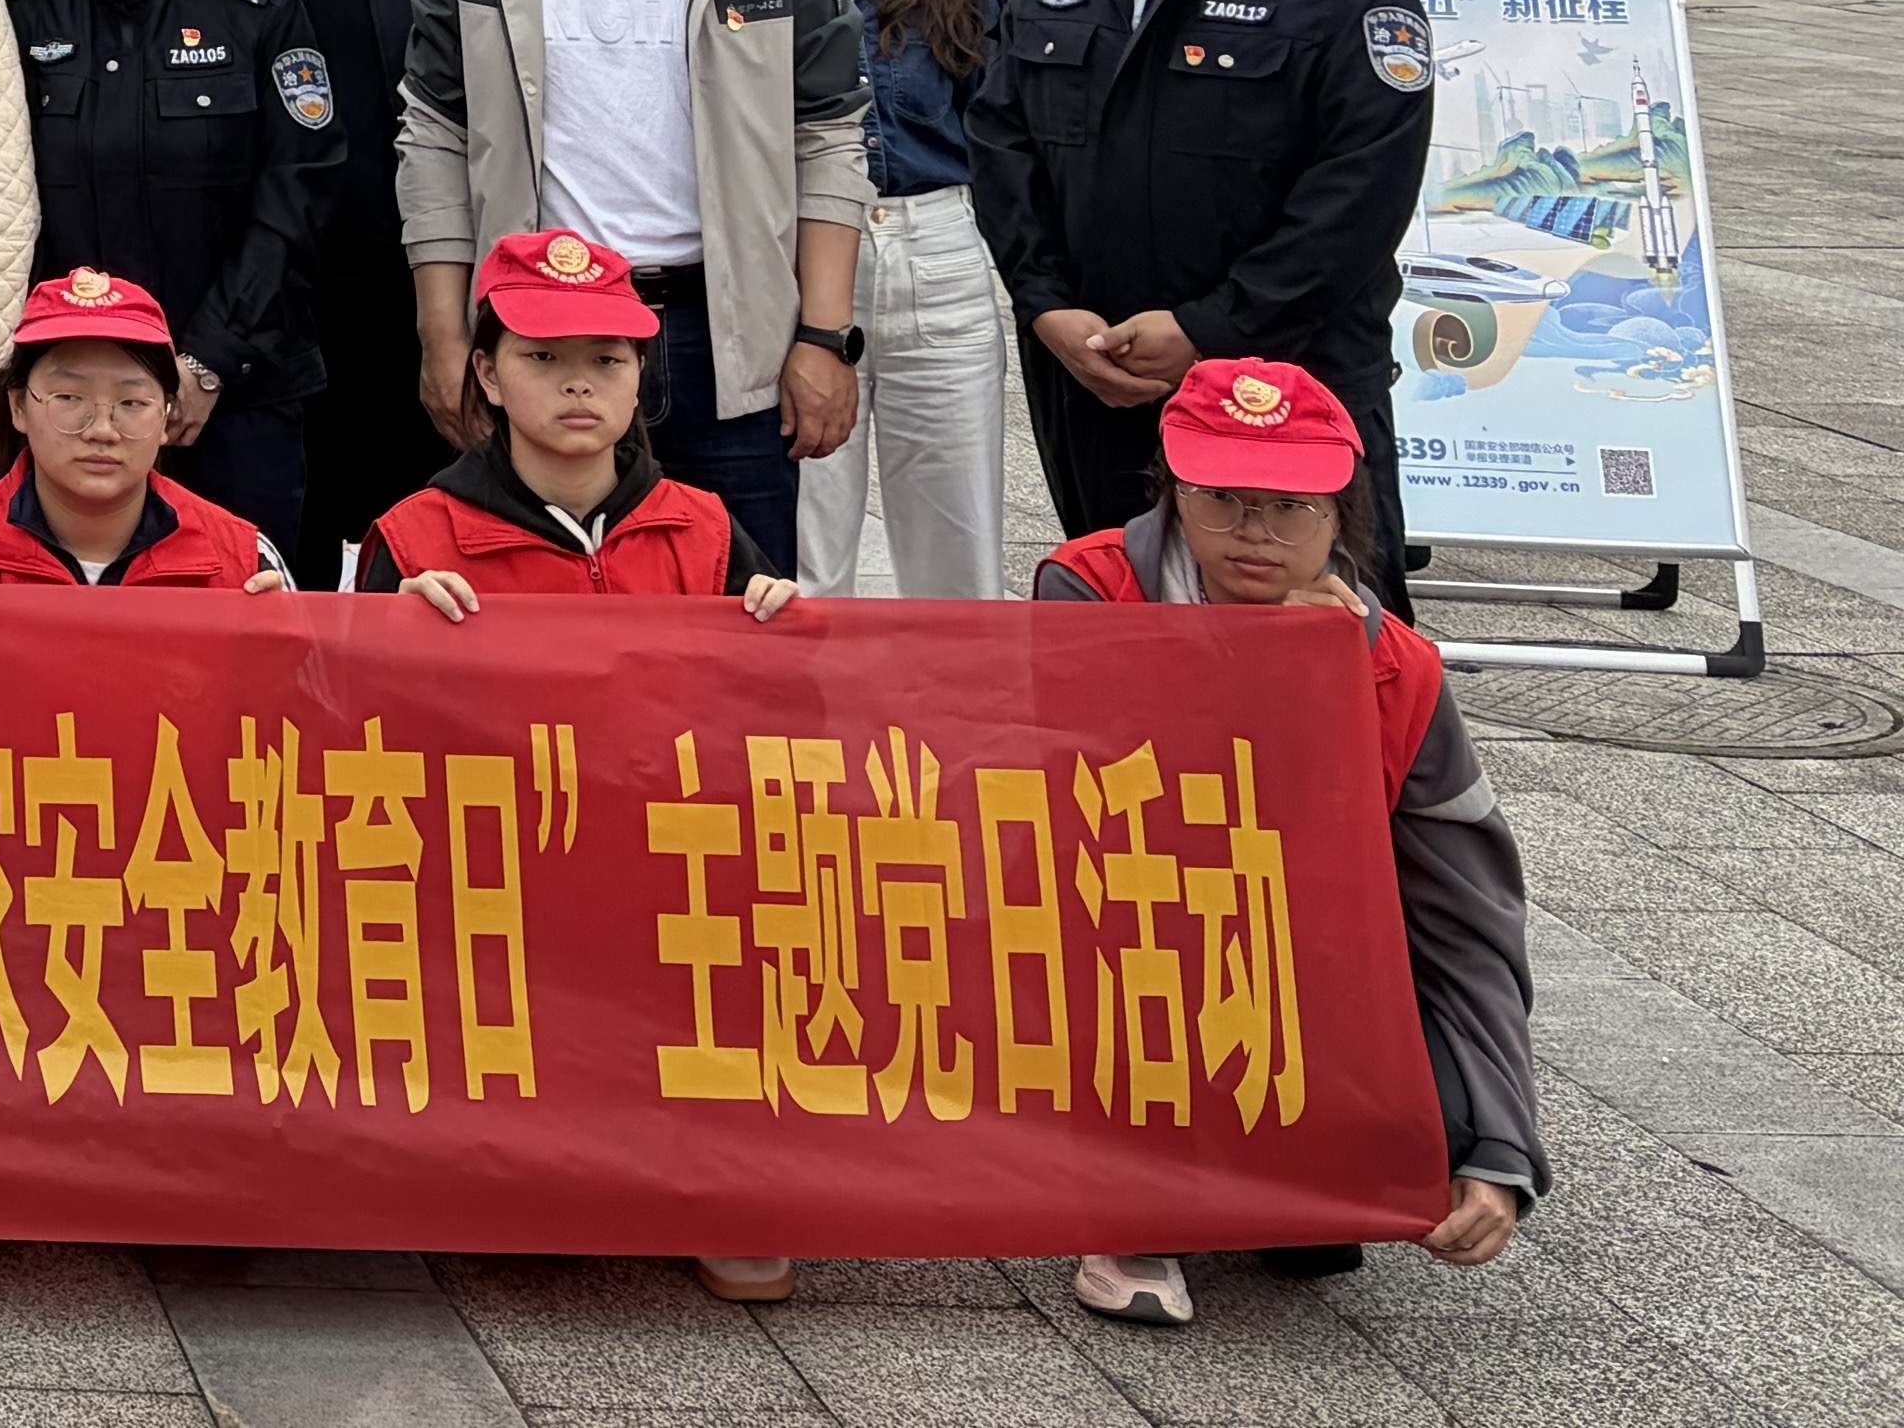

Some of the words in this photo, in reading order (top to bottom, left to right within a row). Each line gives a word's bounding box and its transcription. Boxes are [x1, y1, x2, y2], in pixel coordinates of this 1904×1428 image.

[1204, 0, 1269, 22] ZA0113
[169, 45, 227, 65] ZA0105
[1406, 474, 1581, 494] www.12339.gov.cn
